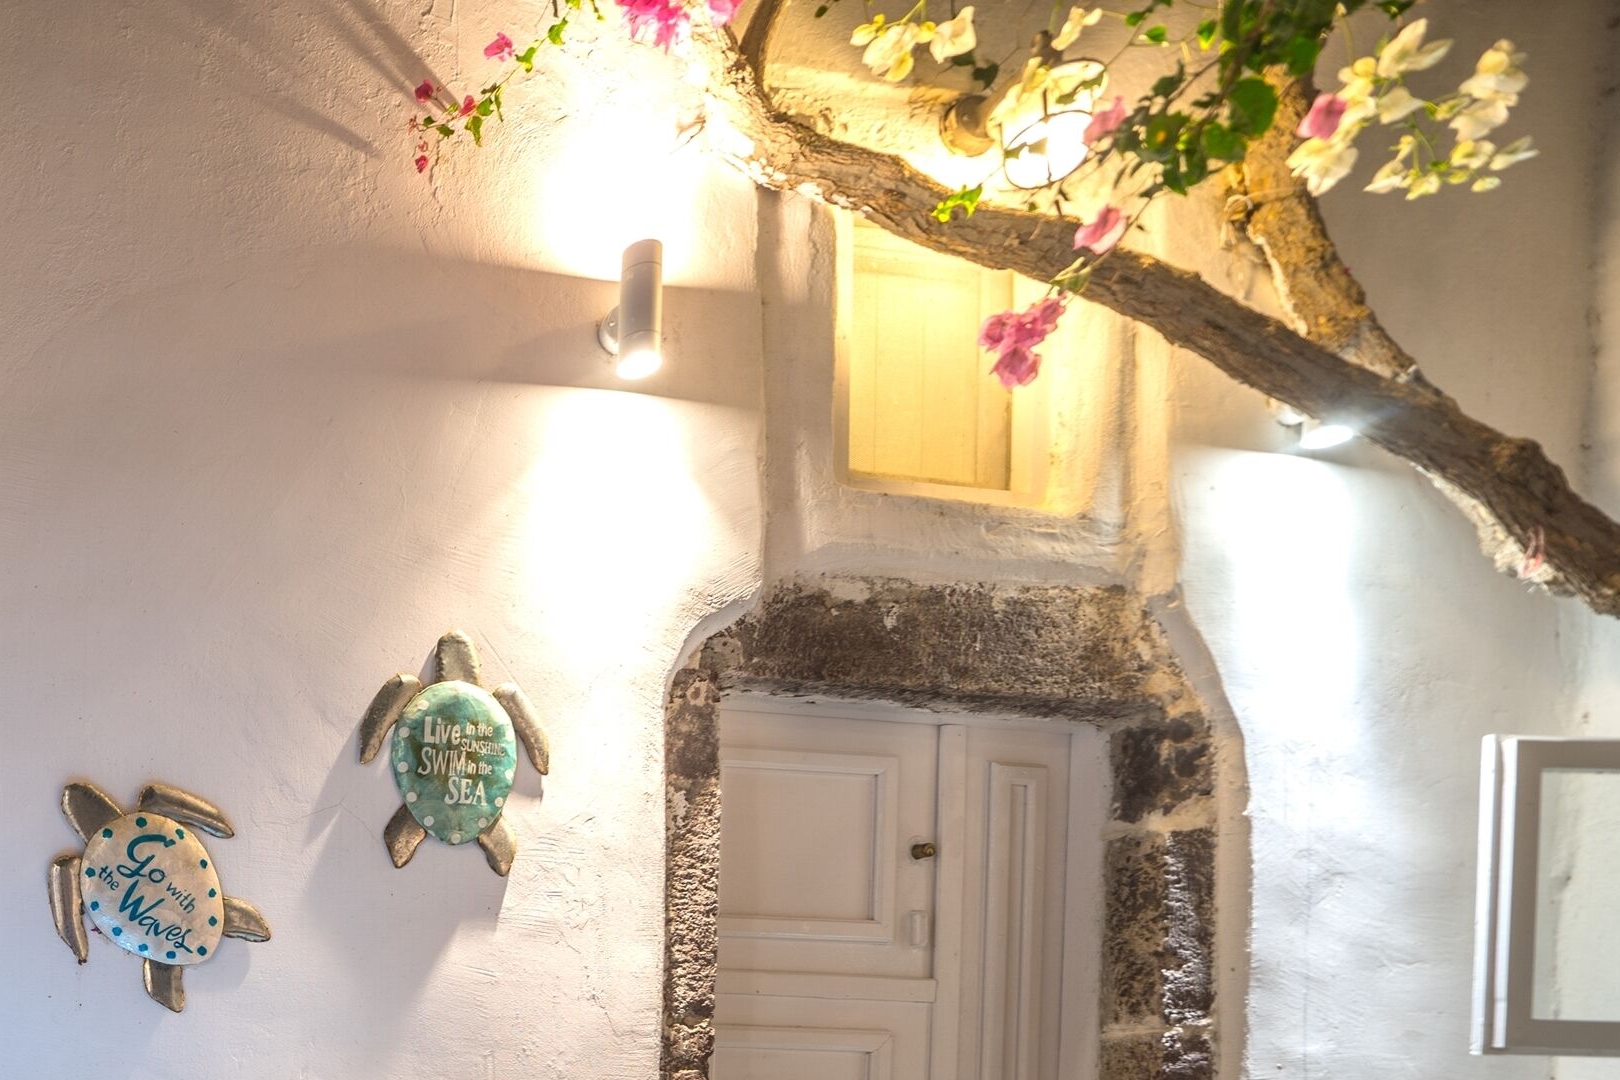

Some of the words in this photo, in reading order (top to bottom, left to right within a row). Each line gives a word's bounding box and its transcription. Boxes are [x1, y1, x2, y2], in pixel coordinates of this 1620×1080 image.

[424, 716, 460, 745] Live
[466, 722, 476, 735] in
[477, 722, 493, 737] the
[417, 746, 466, 776] SWIM
[467, 760, 476, 774] in
[478, 761, 493, 775] the
[444, 776, 488, 806] SEA
[116, 833, 176, 883] Go
[166, 882, 196, 914] with
[98, 865, 119, 890] the
[119, 879, 193, 953] Waves
